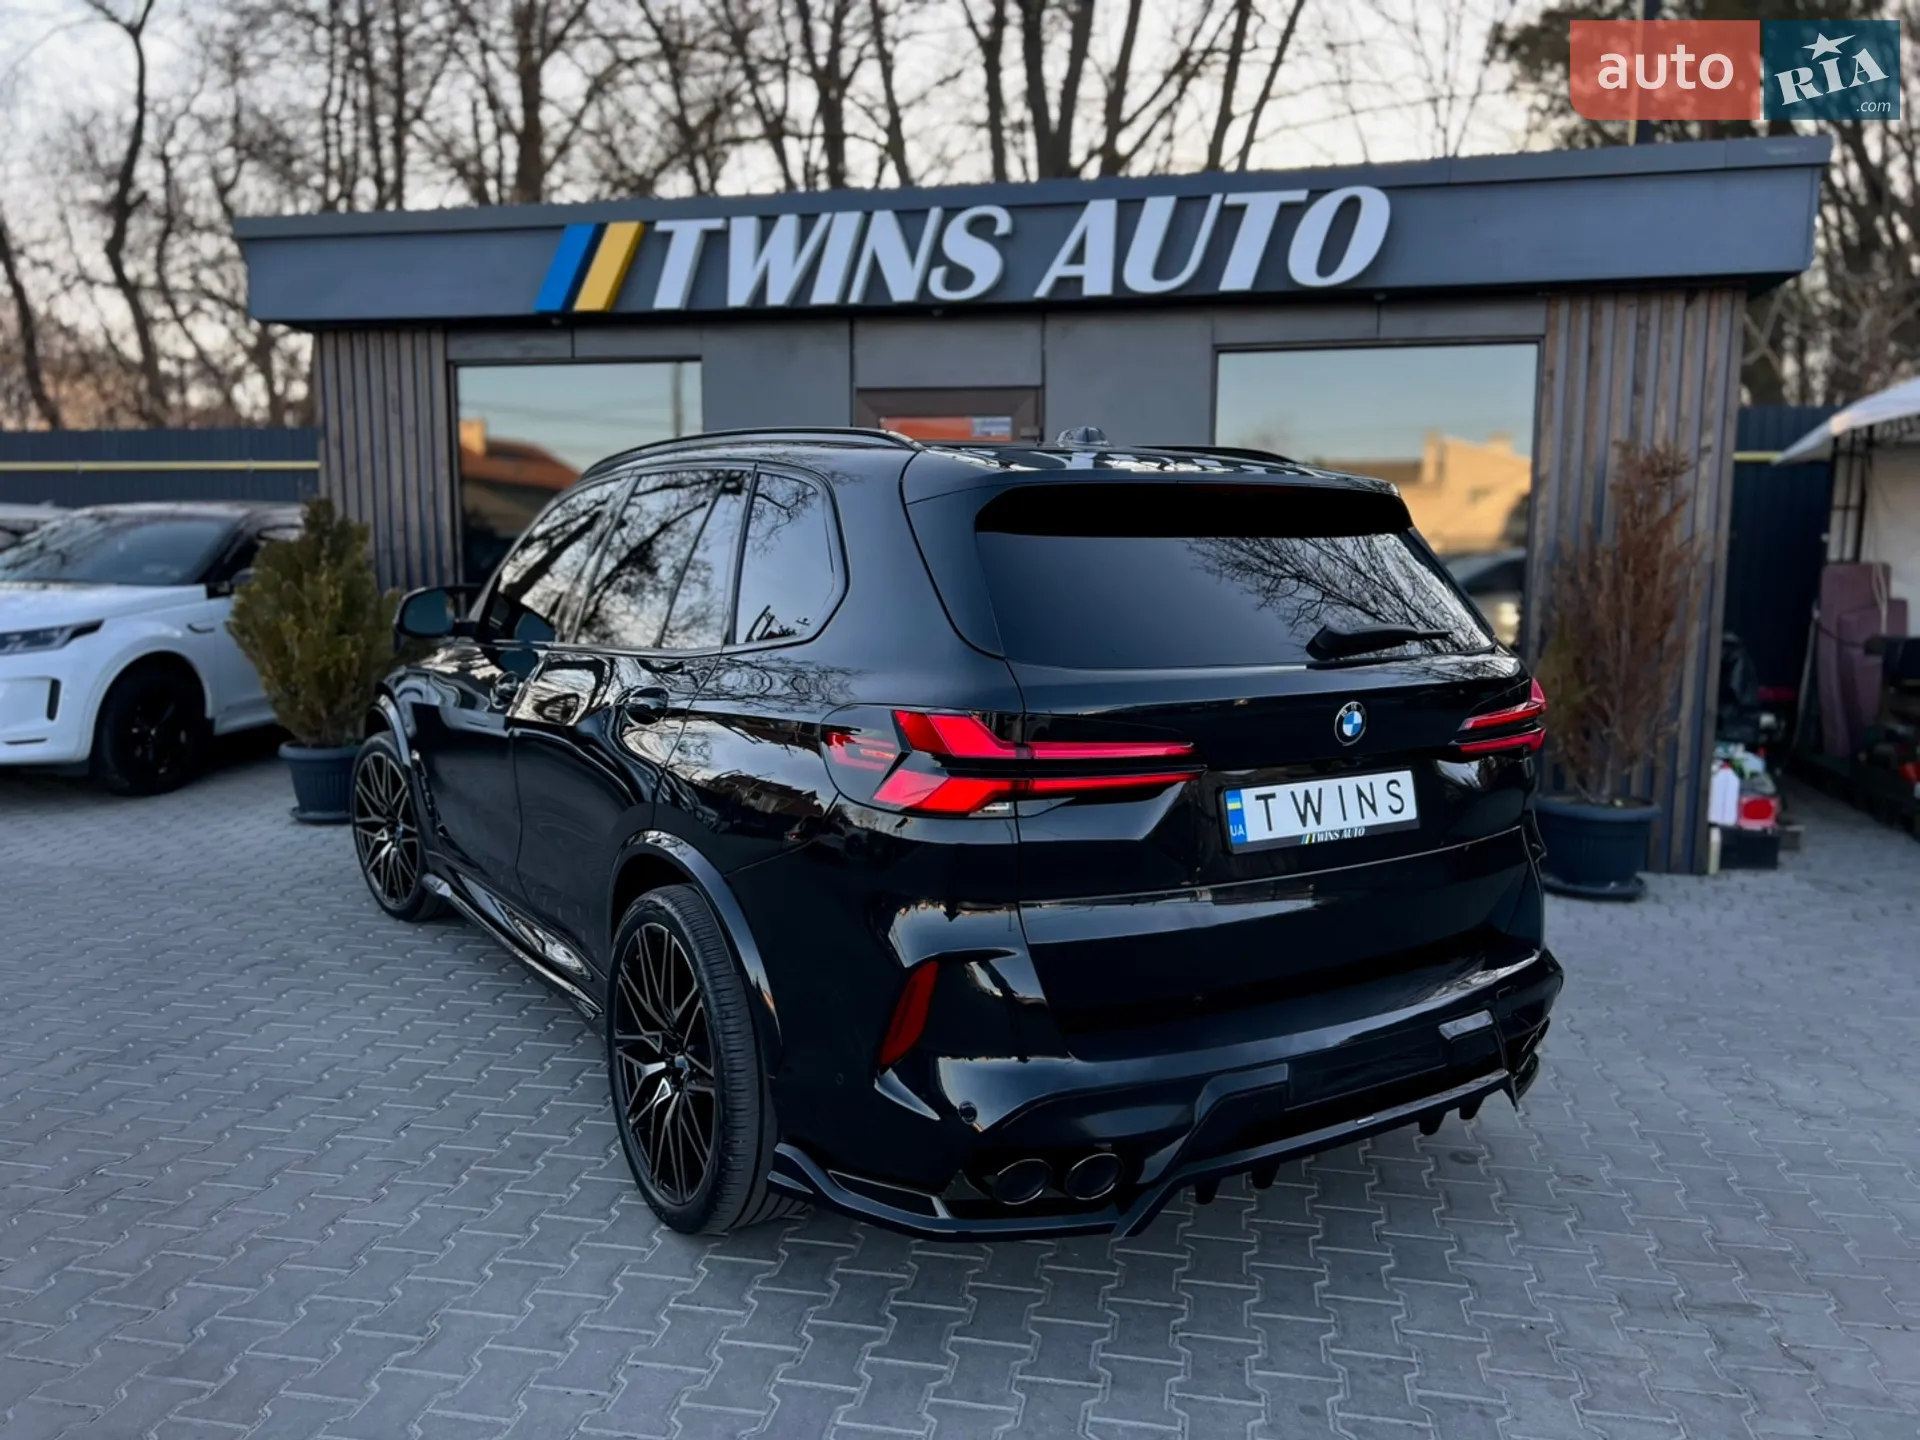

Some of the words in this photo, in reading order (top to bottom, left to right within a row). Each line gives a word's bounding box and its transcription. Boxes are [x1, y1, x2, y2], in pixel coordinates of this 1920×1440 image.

[652, 205, 1012, 310] TWINS
[1034, 186, 1391, 299] AUTO
[1255, 779, 1405, 832] TWINS
[1230, 824, 1245, 837] UA
[1311, 830, 1340, 844] TWINS
[1341, 826, 1366, 839] AUTO
